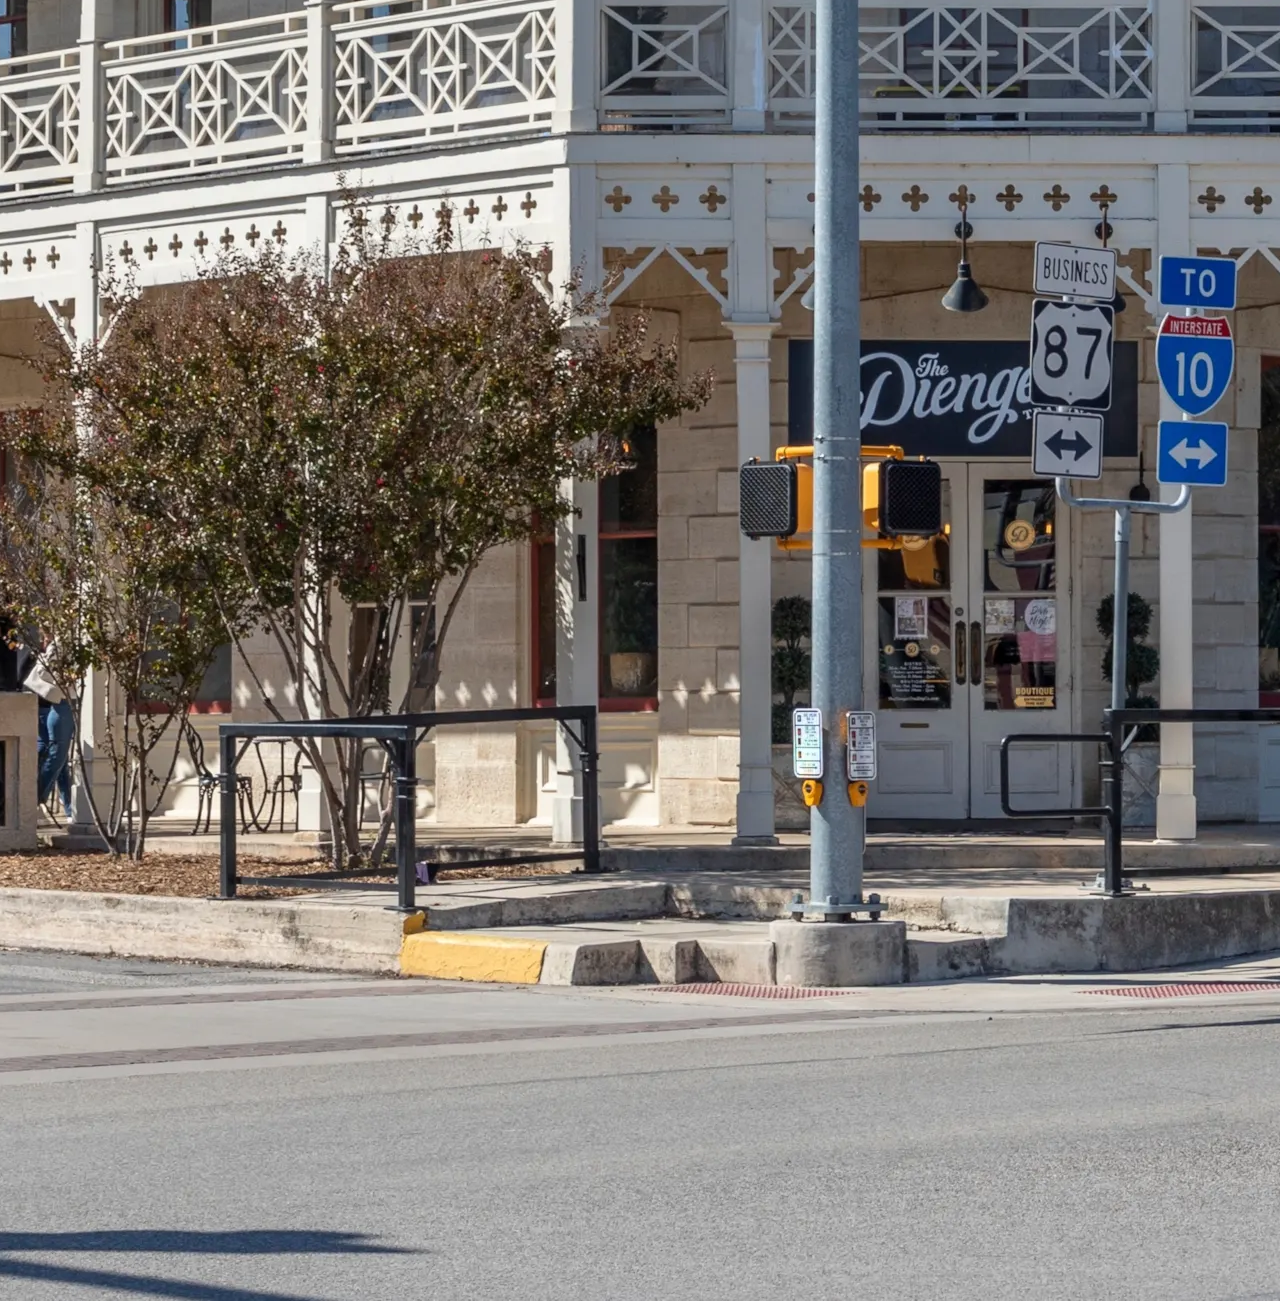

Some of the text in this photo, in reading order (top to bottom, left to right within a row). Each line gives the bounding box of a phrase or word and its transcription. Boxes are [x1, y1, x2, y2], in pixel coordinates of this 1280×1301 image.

[1043, 256, 1109, 286] BUSINESS
[1180, 267, 1217, 298] TO
[1170, 320, 1224, 336] INTERSTATE
[915, 352, 950, 378] The
[1044, 324, 1103, 380] 87
[1176, 351, 1214, 399] 10
[860, 352, 1032, 444] Dienge
[1015, 686, 1055, 696] BOUTIQUE
